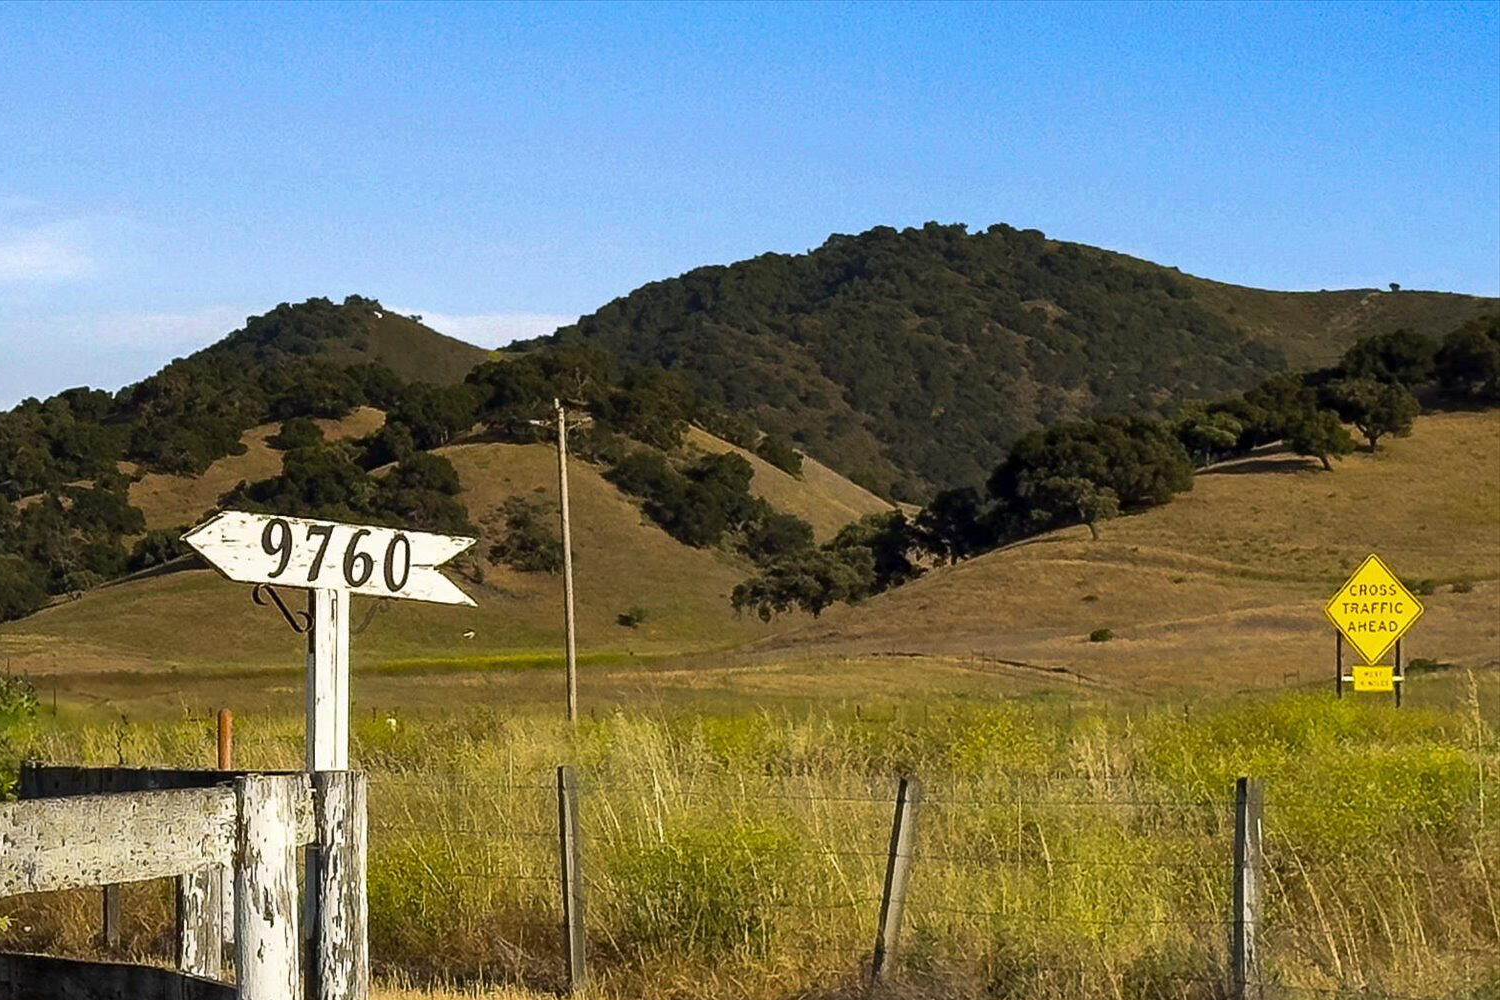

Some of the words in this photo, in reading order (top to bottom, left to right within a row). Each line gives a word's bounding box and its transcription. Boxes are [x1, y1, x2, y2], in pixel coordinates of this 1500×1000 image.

[261, 517, 411, 593] 9760
[1349, 584, 1397, 596] CROSS
[1342, 602, 1404, 614] TRAFFIC
[1347, 620, 1399, 633] AHEAD
